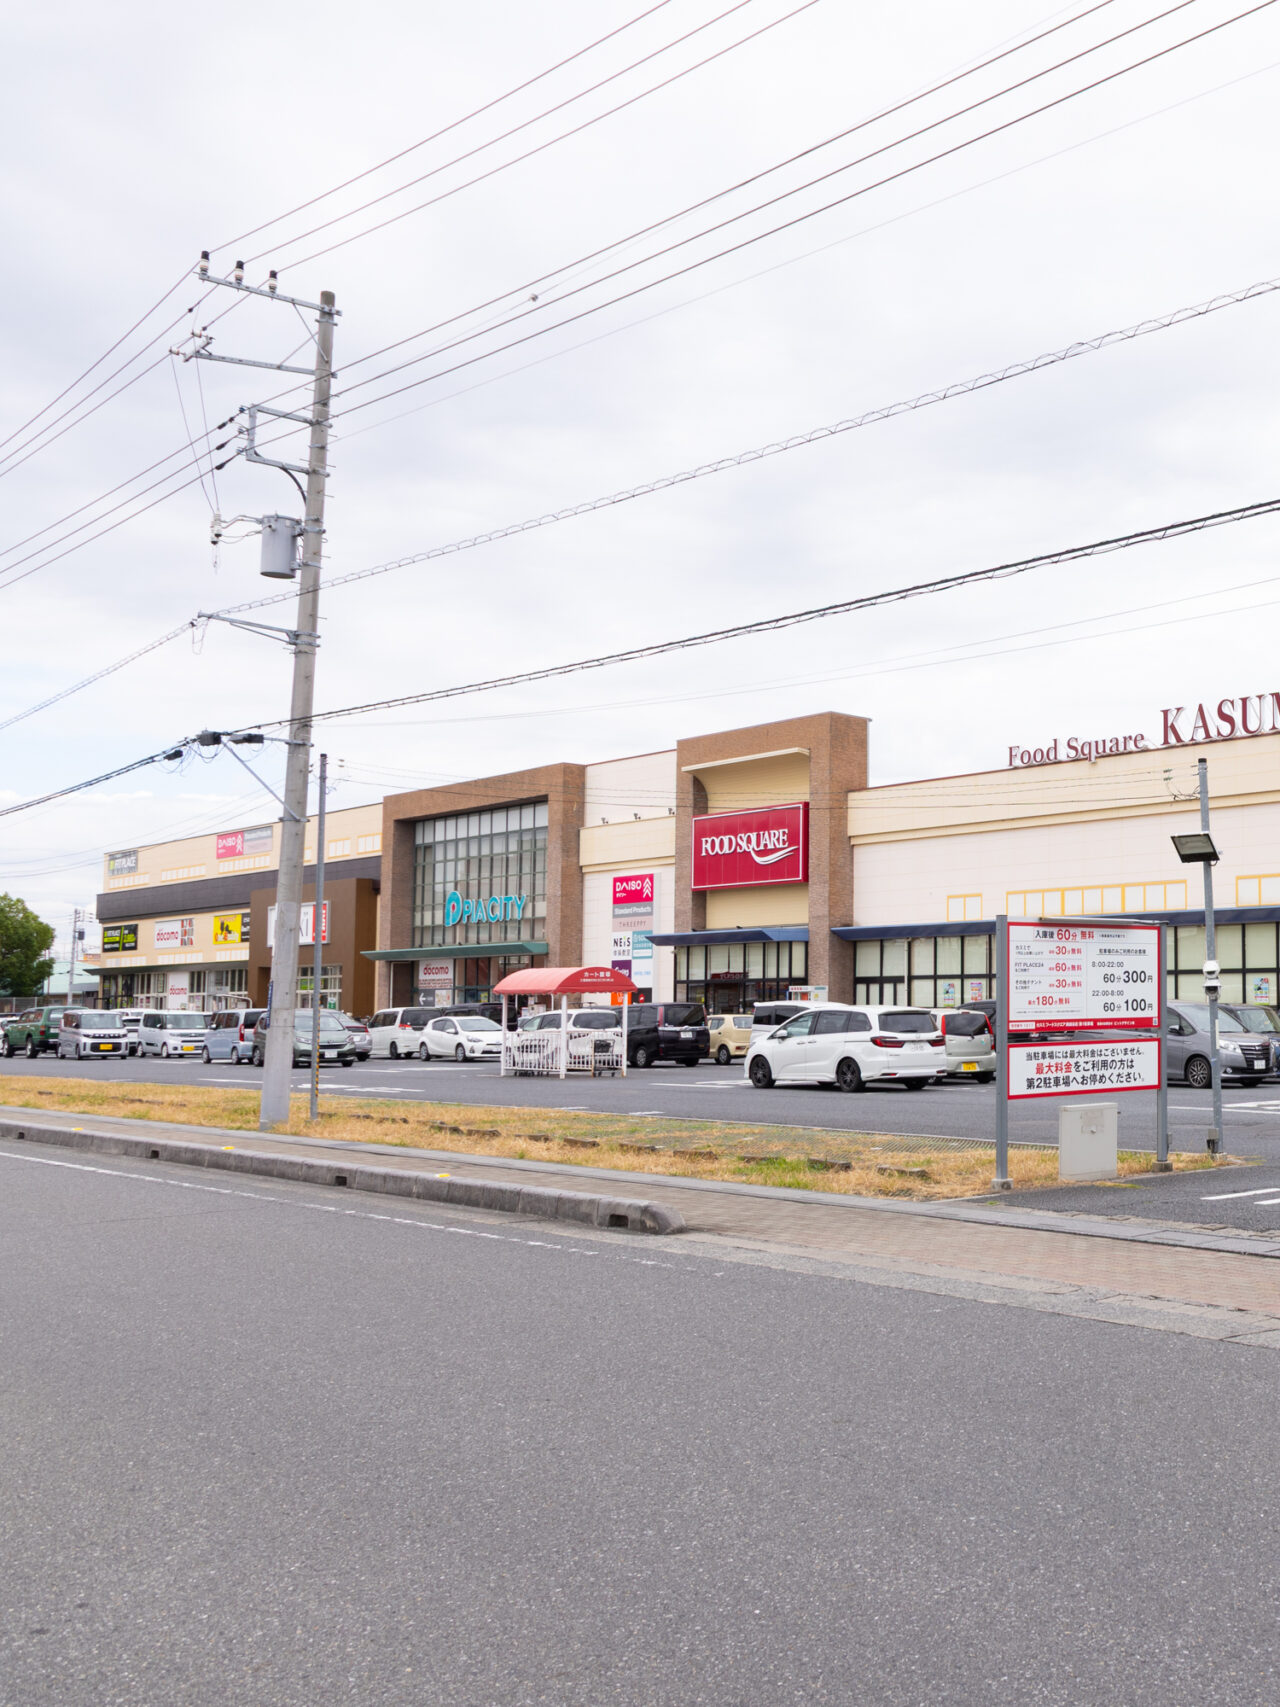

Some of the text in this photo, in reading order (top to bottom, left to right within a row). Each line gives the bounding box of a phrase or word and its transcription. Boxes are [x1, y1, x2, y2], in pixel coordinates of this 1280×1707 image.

[1008, 738, 1058, 767] Food
[1066, 733, 1145, 762] Square
[217, 836, 236, 848] DAISO
[701, 829, 789, 856] FOOD SQUARE
[615, 880, 642, 892] DAISO
[156, 931, 179, 942] docomo
[1081, 930, 1094, 940] 無料
[423, 965, 449, 975] docomo
[1025, 1046, 1144, 1061] 当駐車場には最大料金はございません。
[1035, 1058, 1135, 1075] 最大料金をご利用の方は
[1026, 1072, 1144, 1090] 第2駐車場へお停めください。
